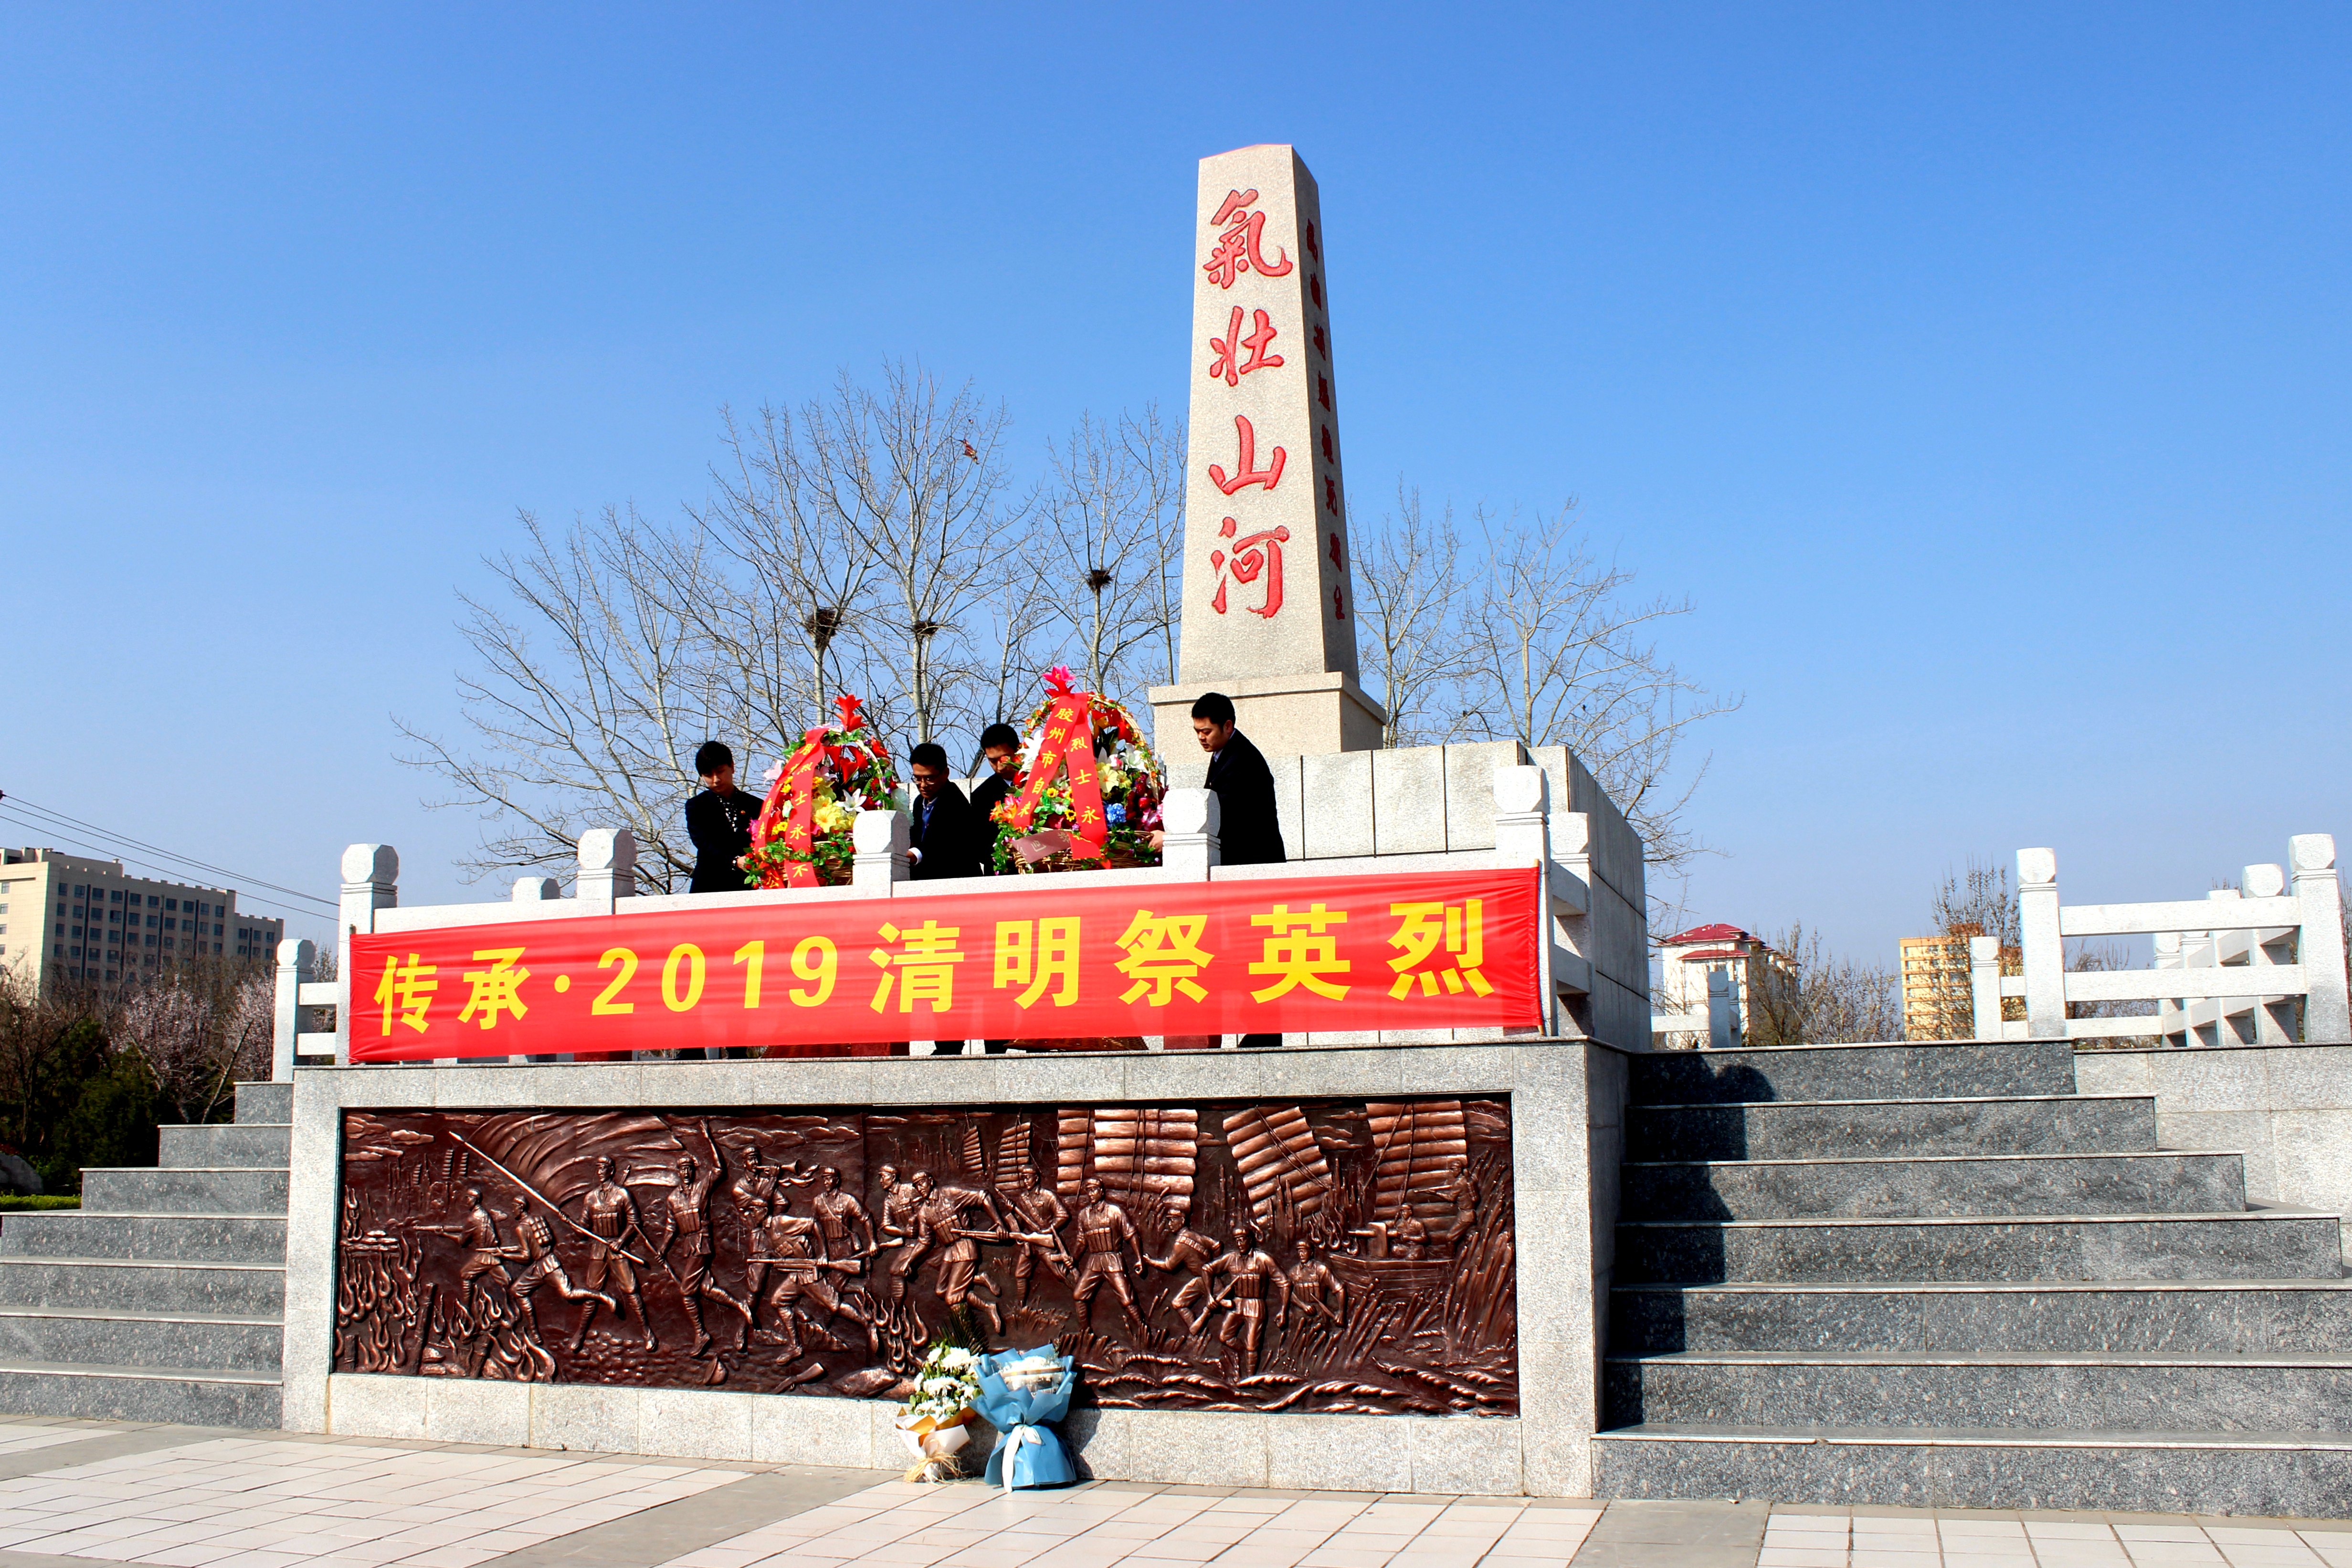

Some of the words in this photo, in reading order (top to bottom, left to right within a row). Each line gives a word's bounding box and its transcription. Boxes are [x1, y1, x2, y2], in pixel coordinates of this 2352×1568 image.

[374, 899, 1494, 1036] 传承·2019清明祭英烈
